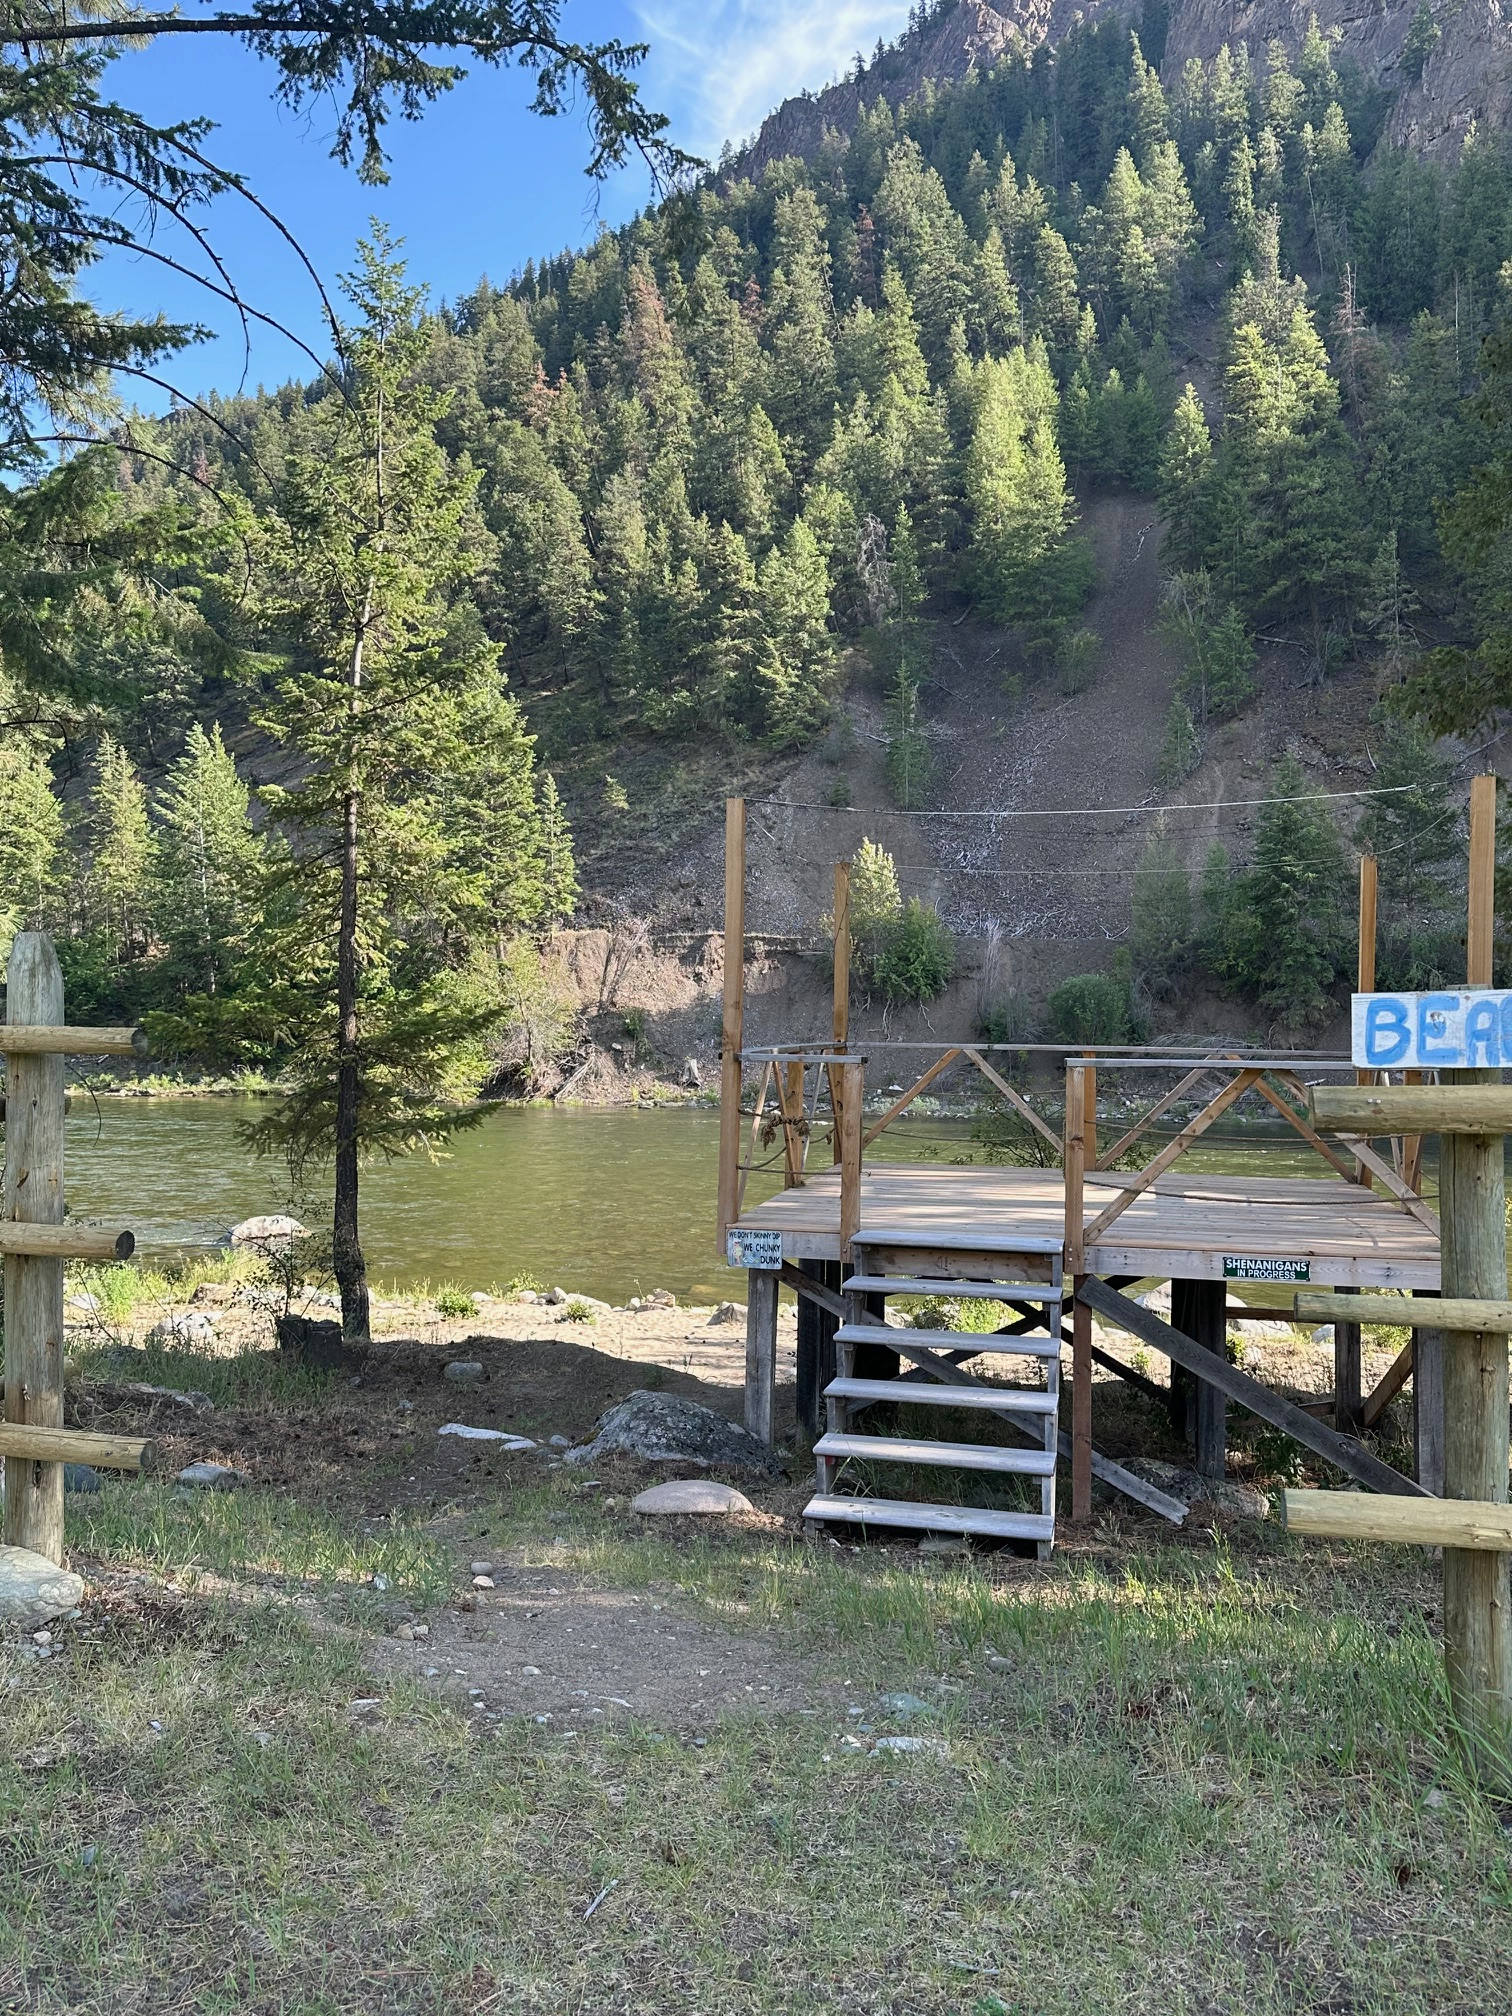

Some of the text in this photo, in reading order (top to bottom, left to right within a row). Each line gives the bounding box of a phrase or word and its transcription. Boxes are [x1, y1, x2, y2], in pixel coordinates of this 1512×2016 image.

[744, 1243, 781, 1252] WE CHUNKY
[760, 1256, 781, 1265] DUNK
[1226, 1259, 1307, 1272] SHENANIGANS
[1237, 1269, 1296, 1279] IN PROGRESS
